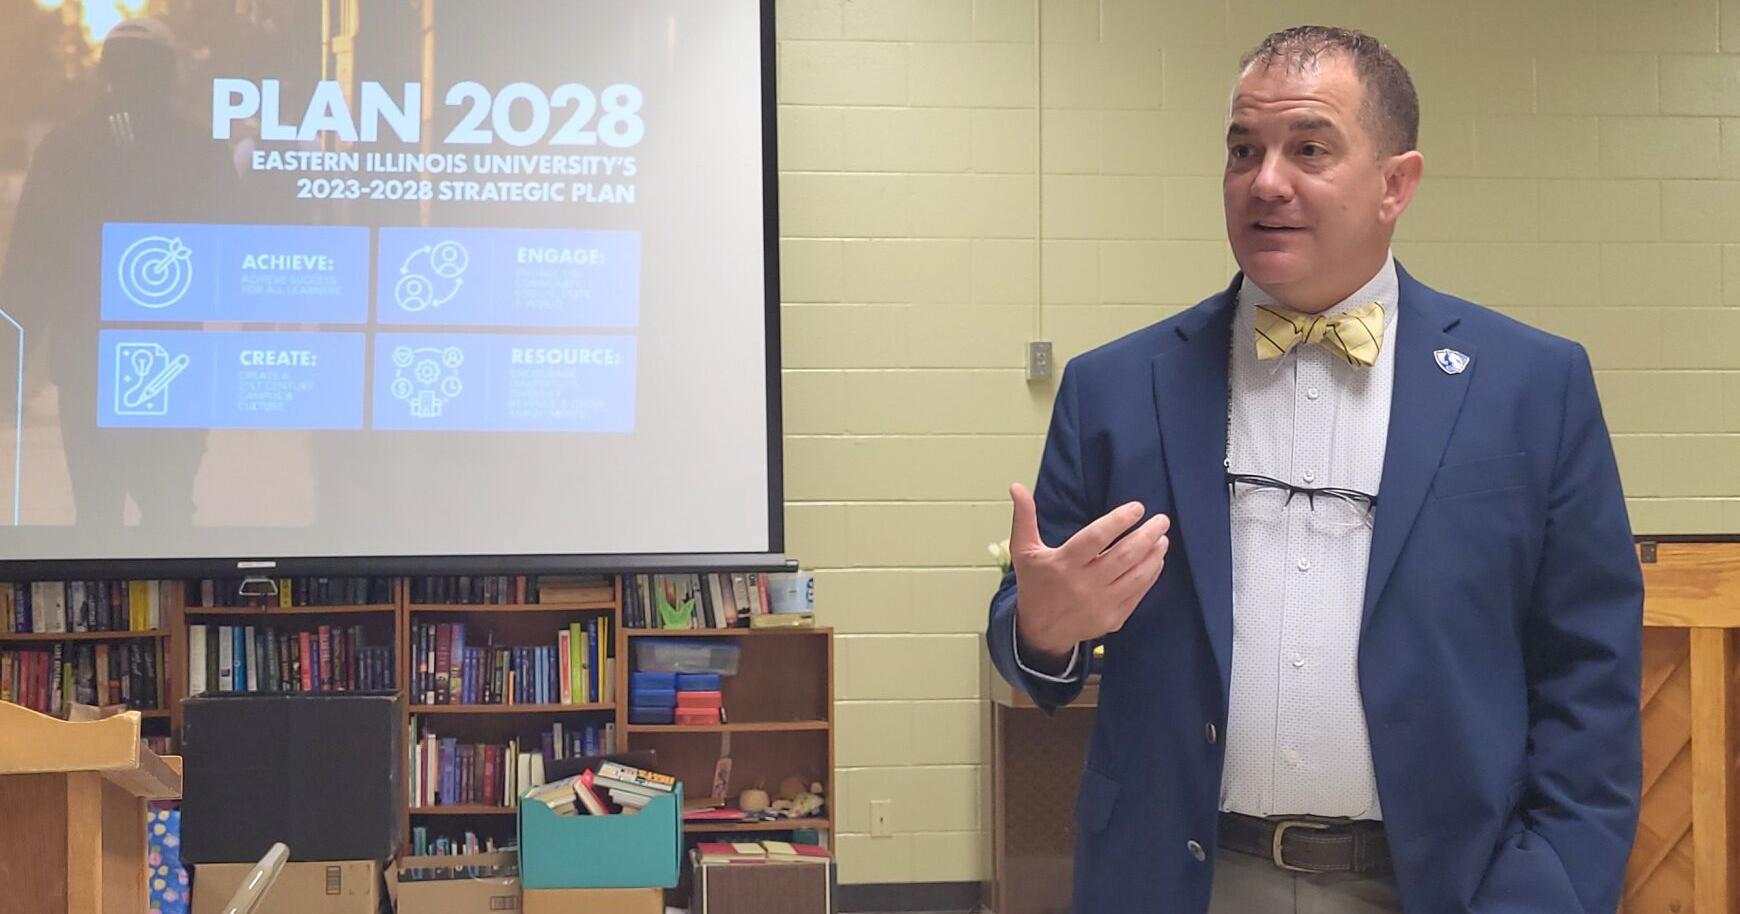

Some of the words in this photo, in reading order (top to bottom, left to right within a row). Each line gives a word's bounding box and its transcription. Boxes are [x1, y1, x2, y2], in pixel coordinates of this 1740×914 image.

[212, 78, 421, 142] PLAN
[444, 81, 645, 147] 2028
[252, 150, 359, 172] EASTERN
[366, 152, 467, 174] ILLINOIS
[474, 154, 637, 176] UNIVERSITY'S
[297, 179, 433, 200] 2023-2028
[439, 180, 565, 202] STRATEGIC
[571, 183, 636, 203] PLAN
[242, 254, 334, 271] ACHIEVE:
[517, 247, 606, 265] ENGAGE:
[240, 350, 317, 366] CREATE:
[511, 348, 621, 365] RESOURCE:
